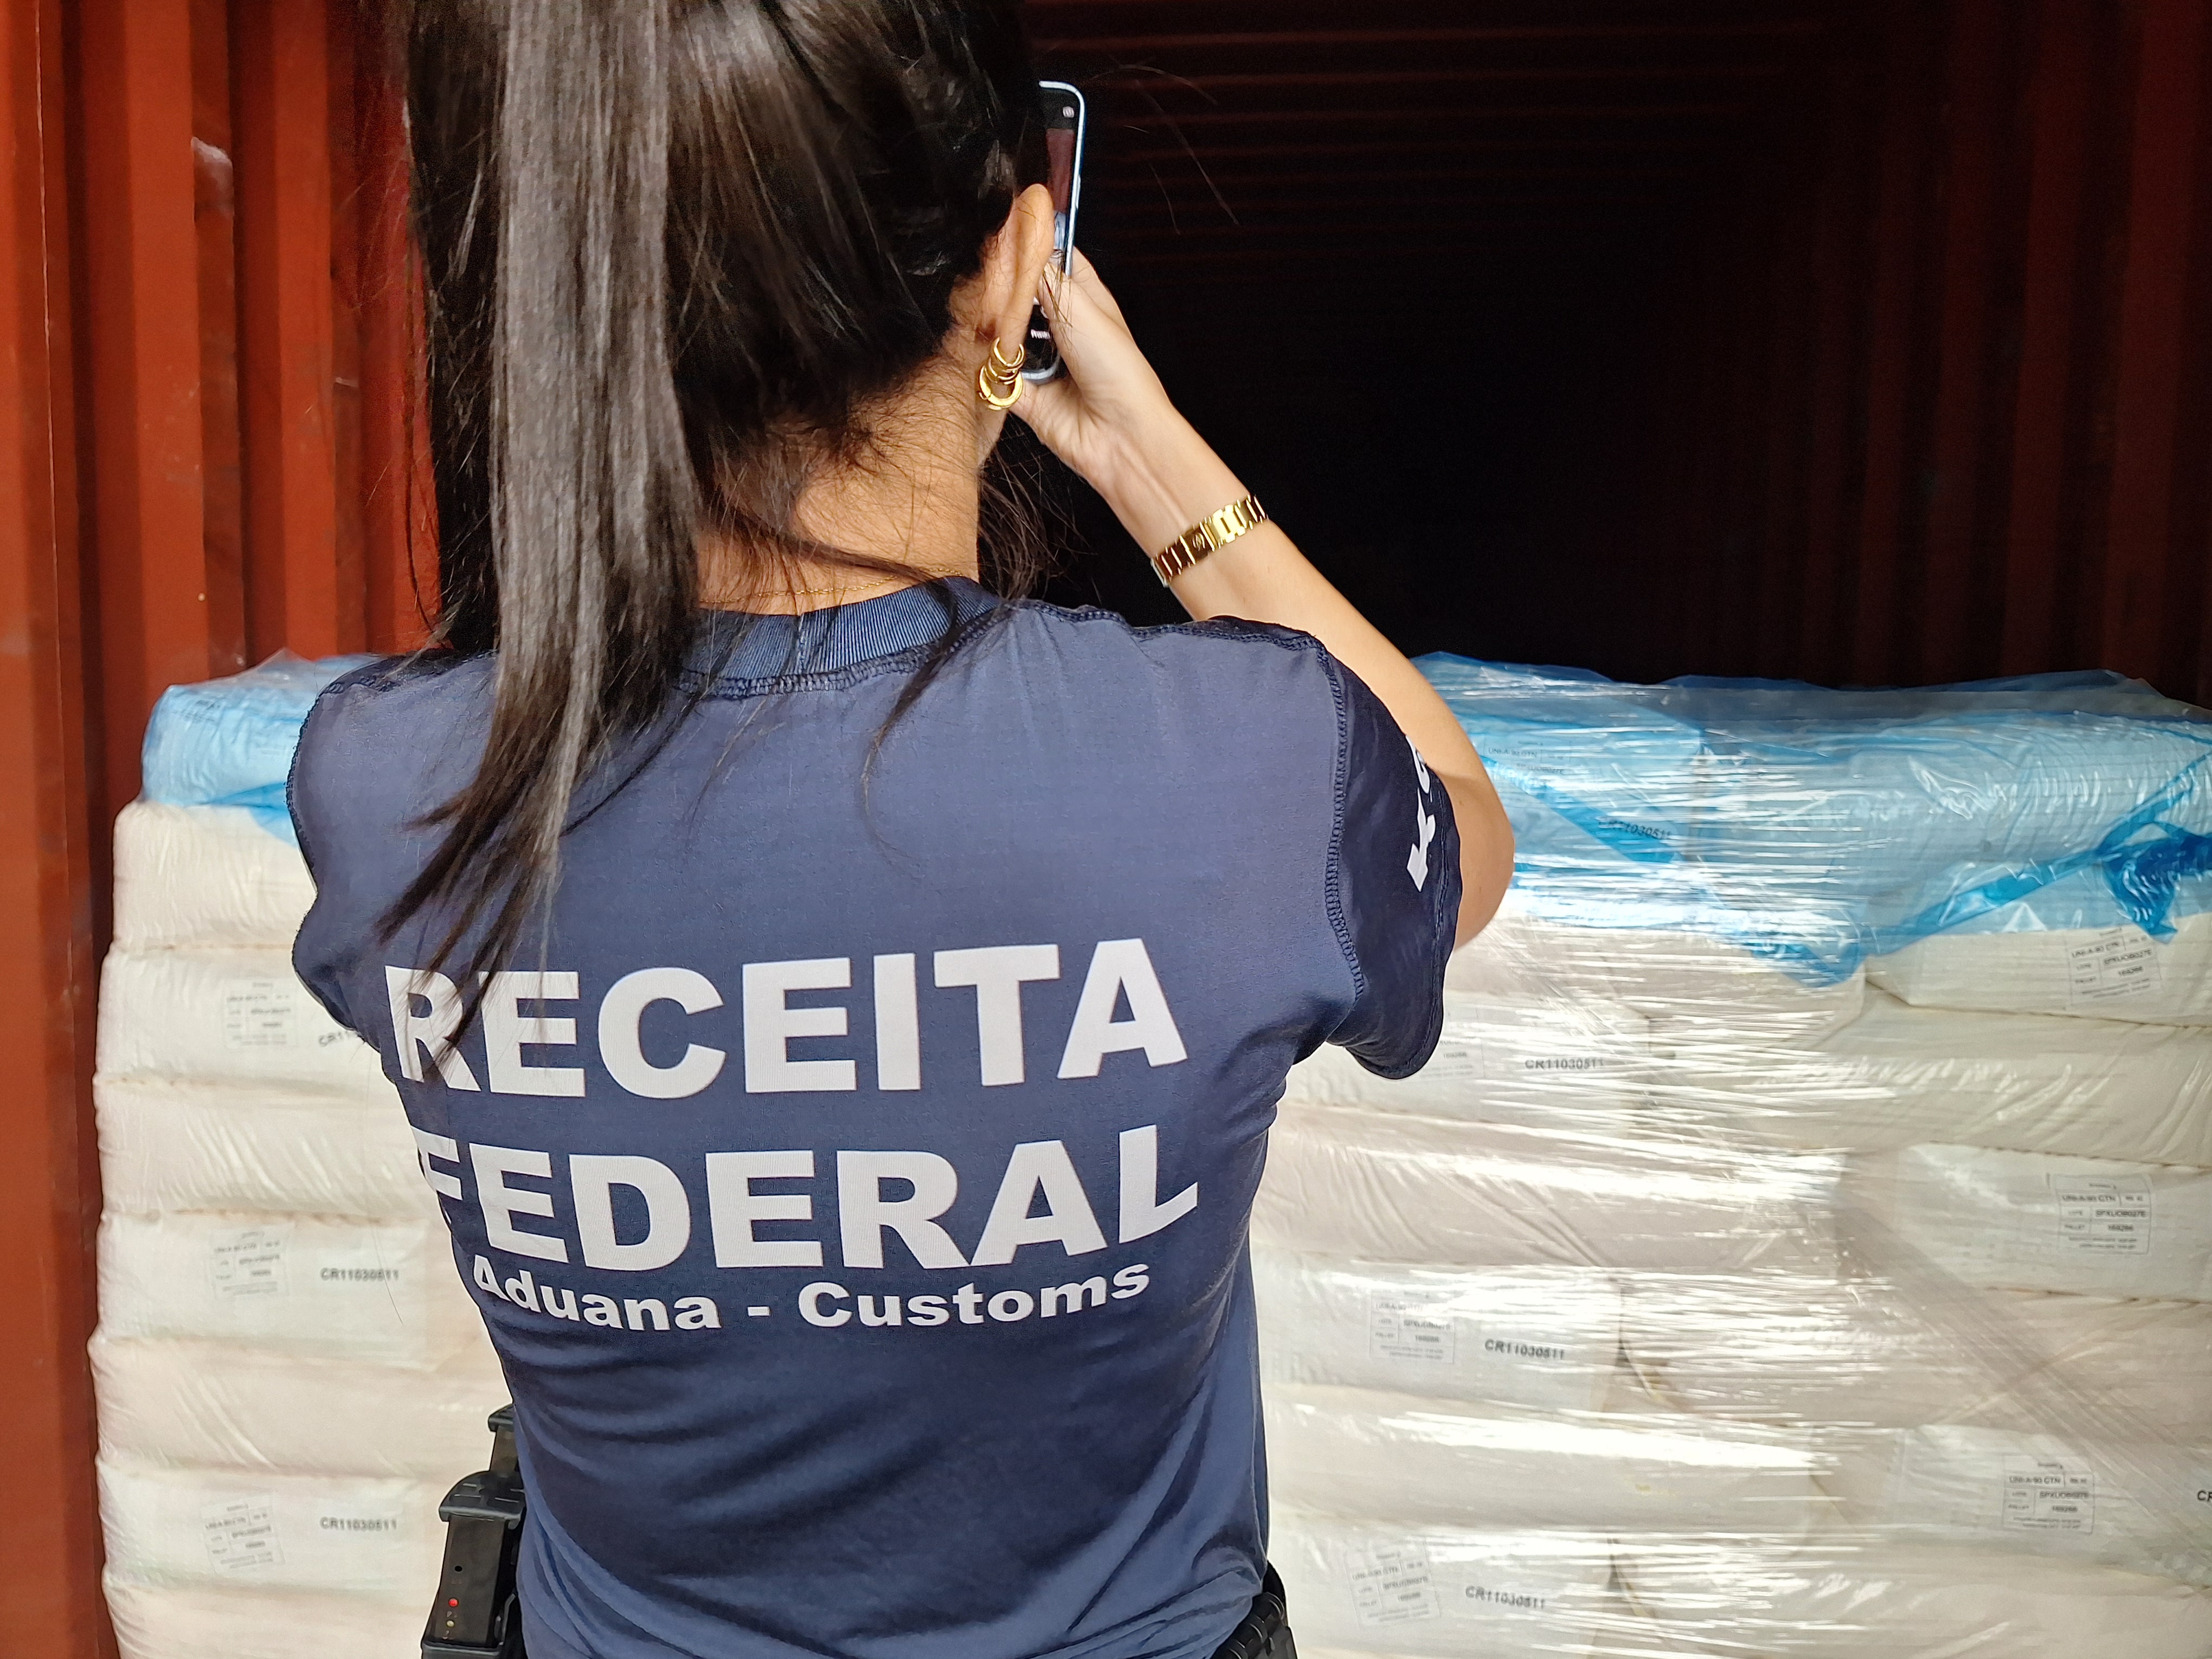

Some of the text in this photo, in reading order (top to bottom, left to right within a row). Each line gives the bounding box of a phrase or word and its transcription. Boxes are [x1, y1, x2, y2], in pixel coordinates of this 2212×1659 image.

[385, 938, 1188, 1099] RECEITA
[1525, 1059, 1604, 1070] CR11030511
[410, 1124, 1198, 1271] FEDERAL
[473, 1255, 722, 1330] Aduana
[798, 1264, 1150, 1327] Customs
[1484, 1338, 1565, 1360] CR11030511
[1465, 1585, 1545, 1610] CR11030511
